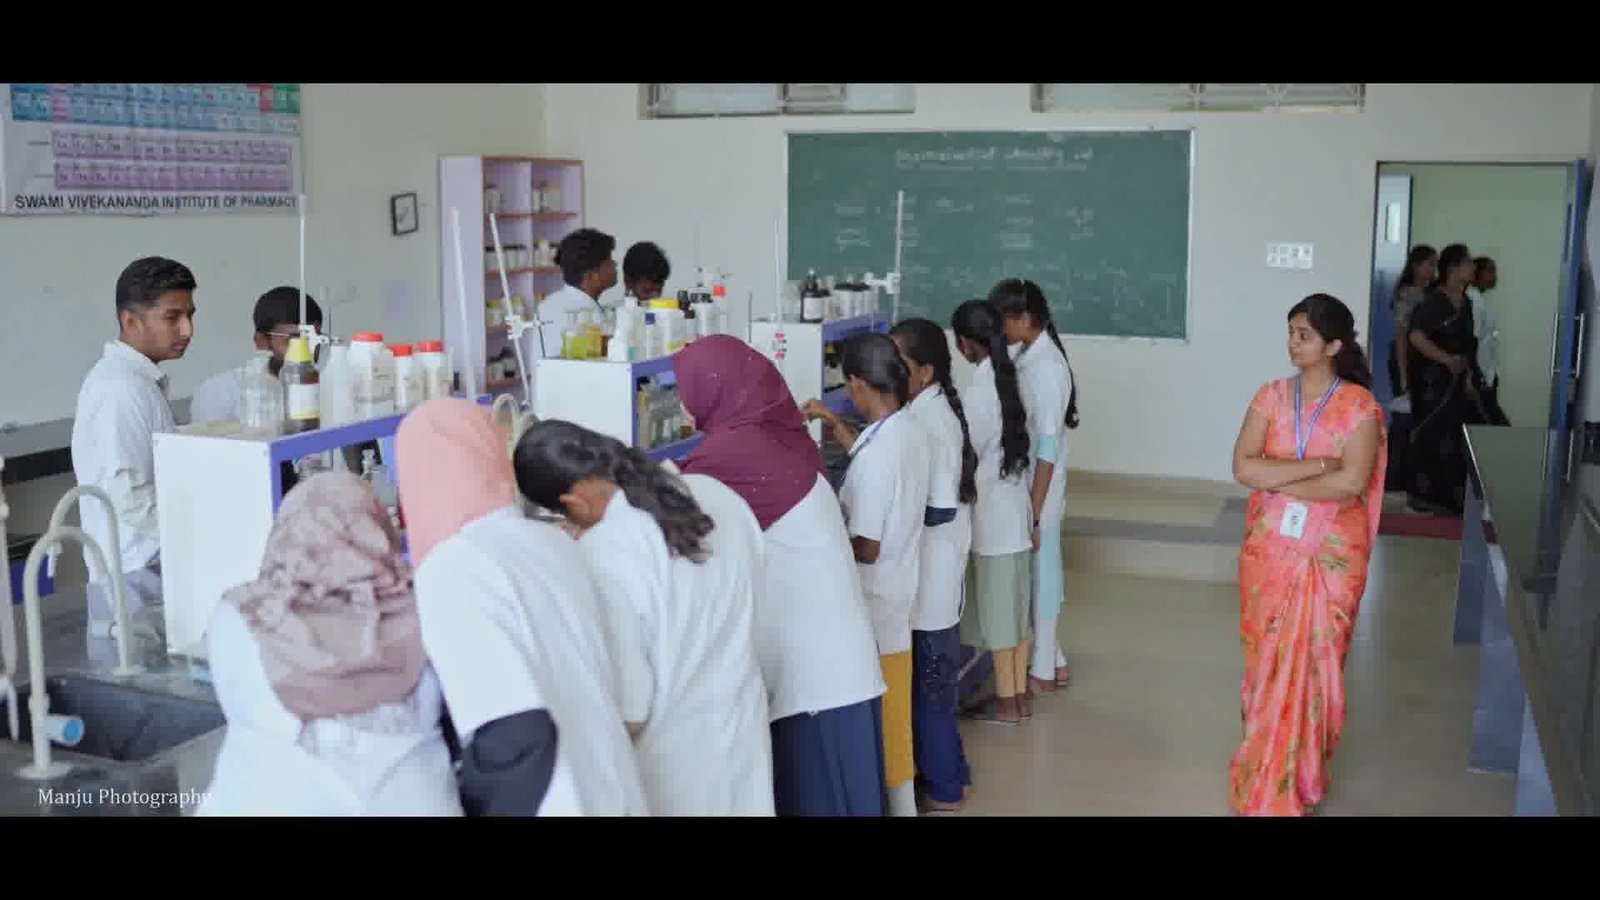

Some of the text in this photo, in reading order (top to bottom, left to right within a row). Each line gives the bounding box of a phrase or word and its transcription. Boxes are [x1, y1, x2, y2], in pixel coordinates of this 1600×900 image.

[15, 193, 297, 209] SWAMI VIVEKANANDA INSTITUTE OF PHARMACY
